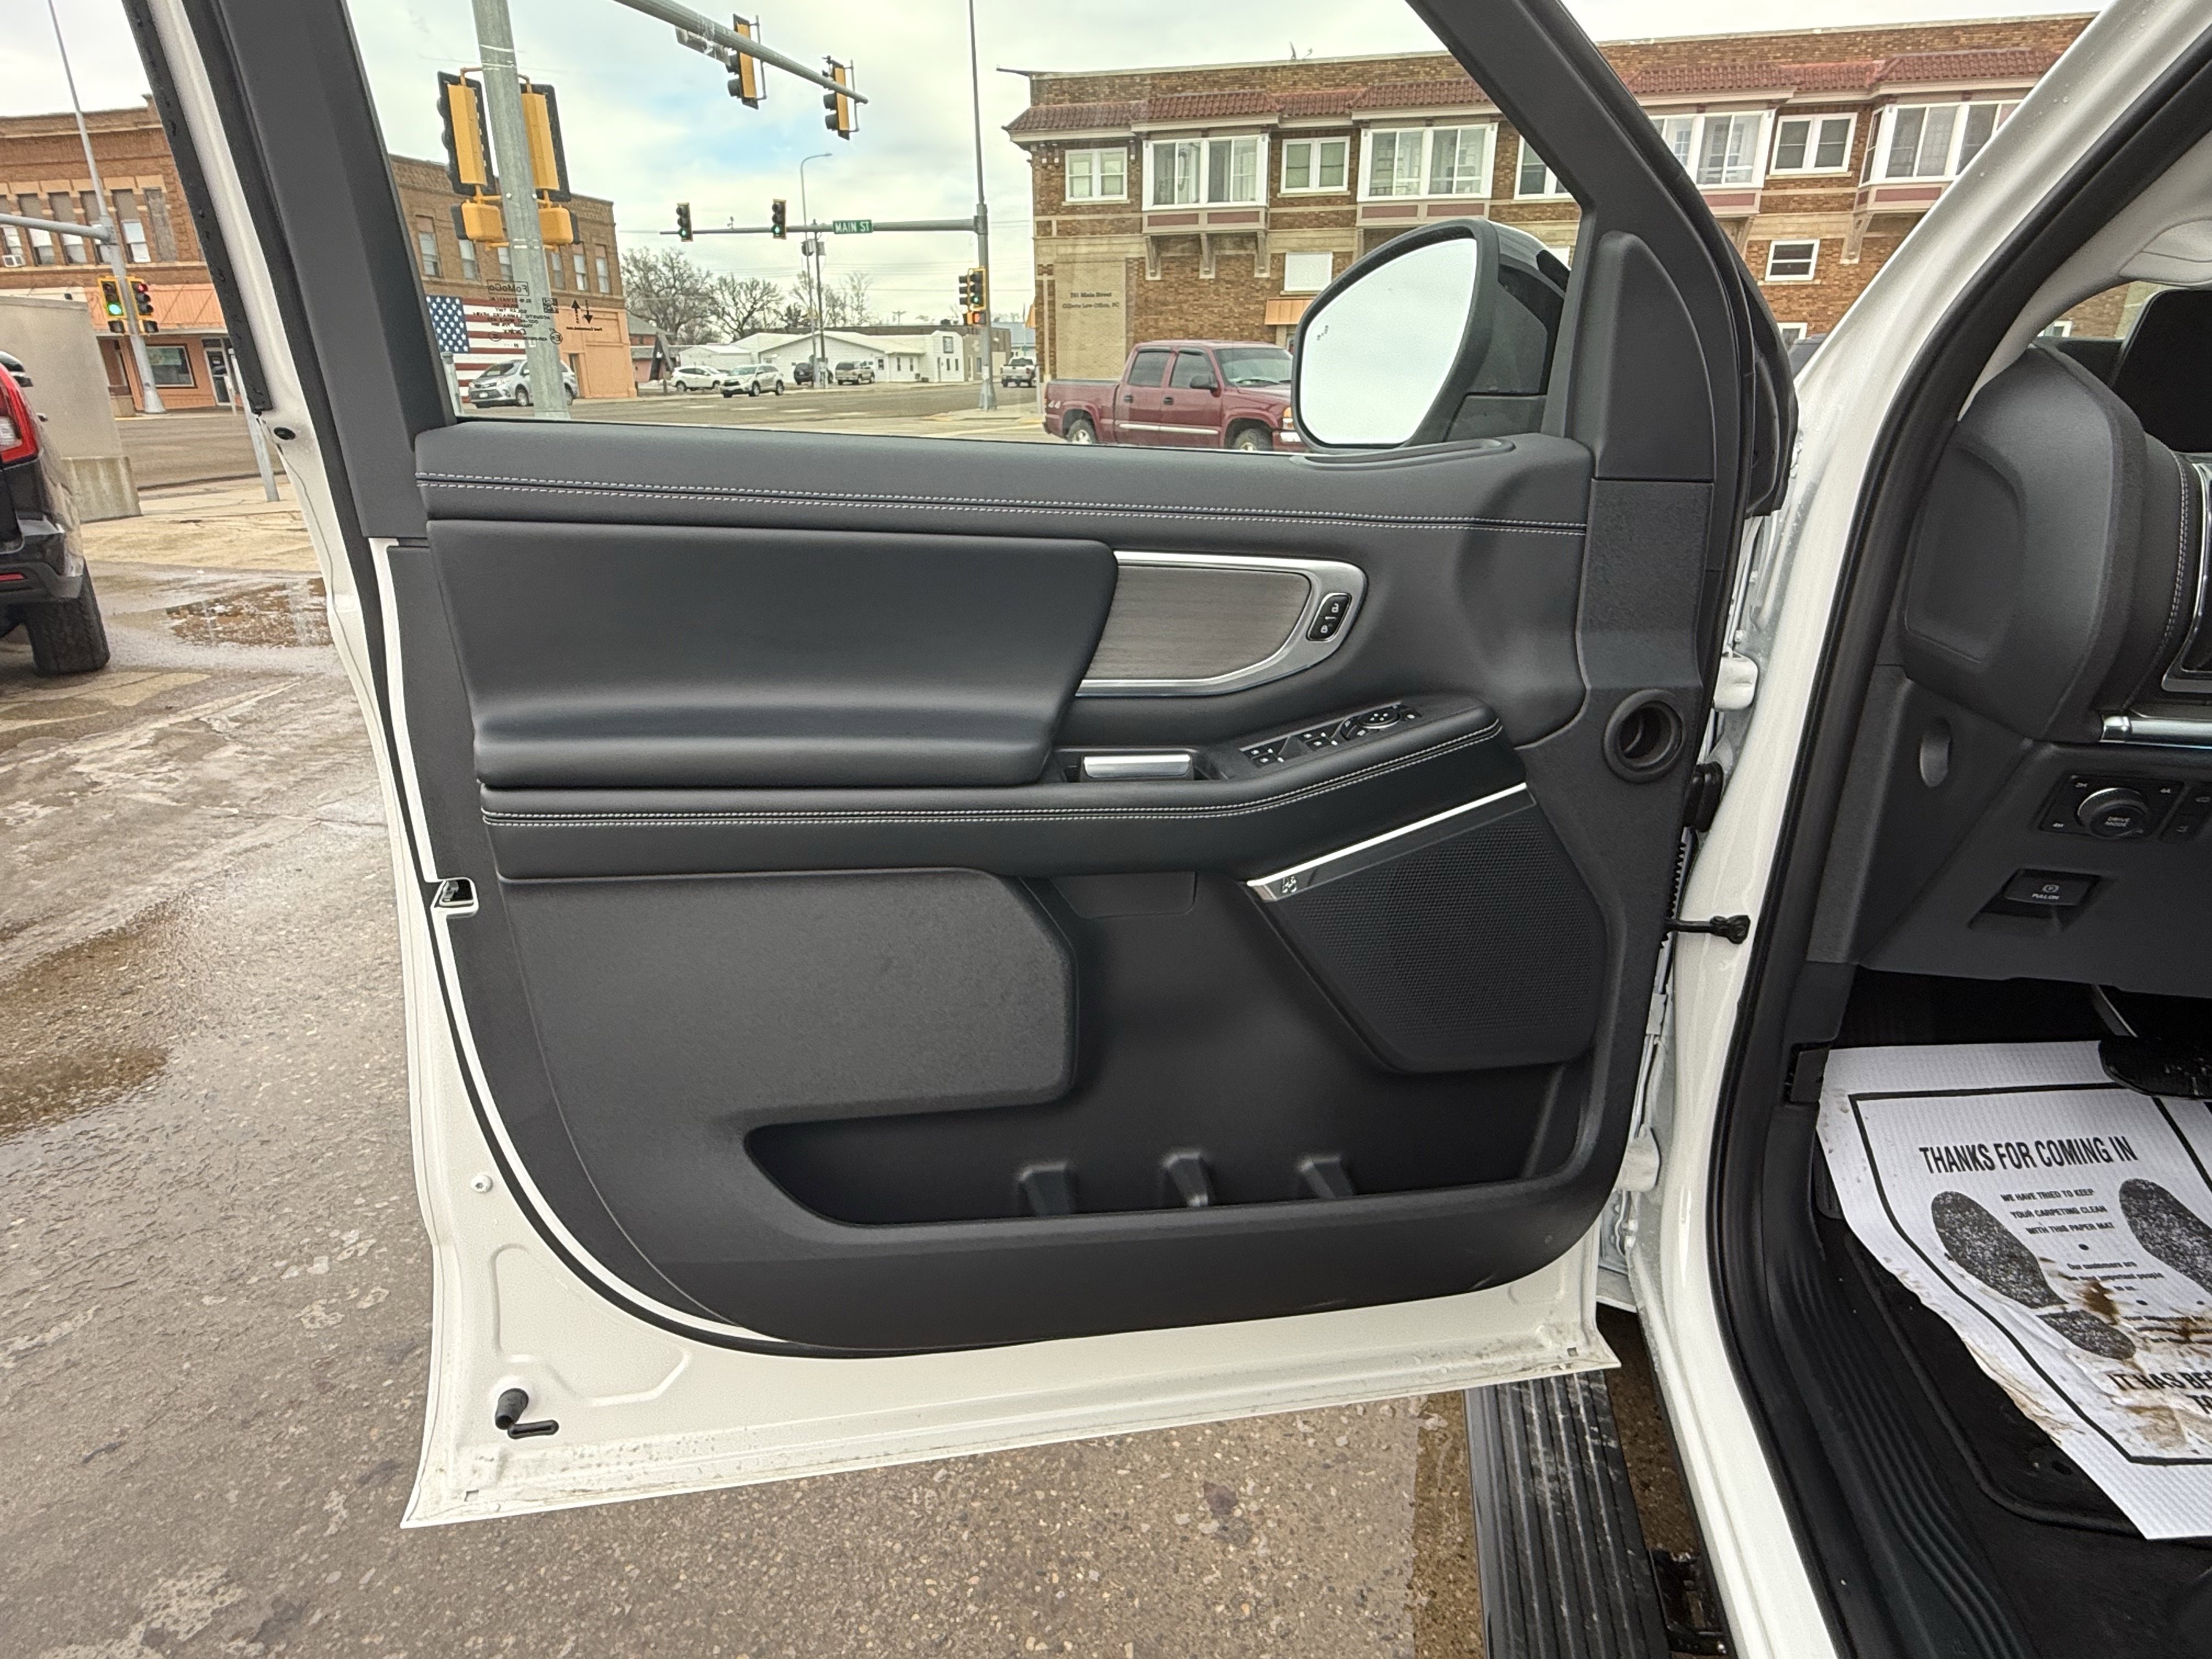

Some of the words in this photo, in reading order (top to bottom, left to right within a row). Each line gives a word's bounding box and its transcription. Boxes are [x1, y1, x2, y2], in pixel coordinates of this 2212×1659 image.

[834, 222, 857, 233] MAIN
[860, 221, 870, 232] ST
[1919, 1143, 1996, 1174] THANKS
[1993, 1142, 2038, 1170] FOR
[2034, 1136, 2114, 1167] COMING
[2108, 1136, 2138, 1161] IN
[2000, 1193, 2016, 1201] WE
[2015, 1192, 2038, 1201] HAVE
[2036, 1190, 2062, 1199] TRIED
[2061, 1189, 2074, 1198] TO
[2074, 1188, 2095, 1197] KEEP
[2010, 1210, 2035, 1219] YOUR
[2034, 1207, 2081, 1217] CARPETING
[2080, 1205, 2108, 1214] CLEAN
[2025, 1226, 2050, 1234] WITH
[2048, 1224, 2069, 1233] THIS
[2068, 1223, 2097, 1232] PAPER
[2107, 1373, 2138, 1391] IT
[2132, 1372, 2188, 1390] HAS
